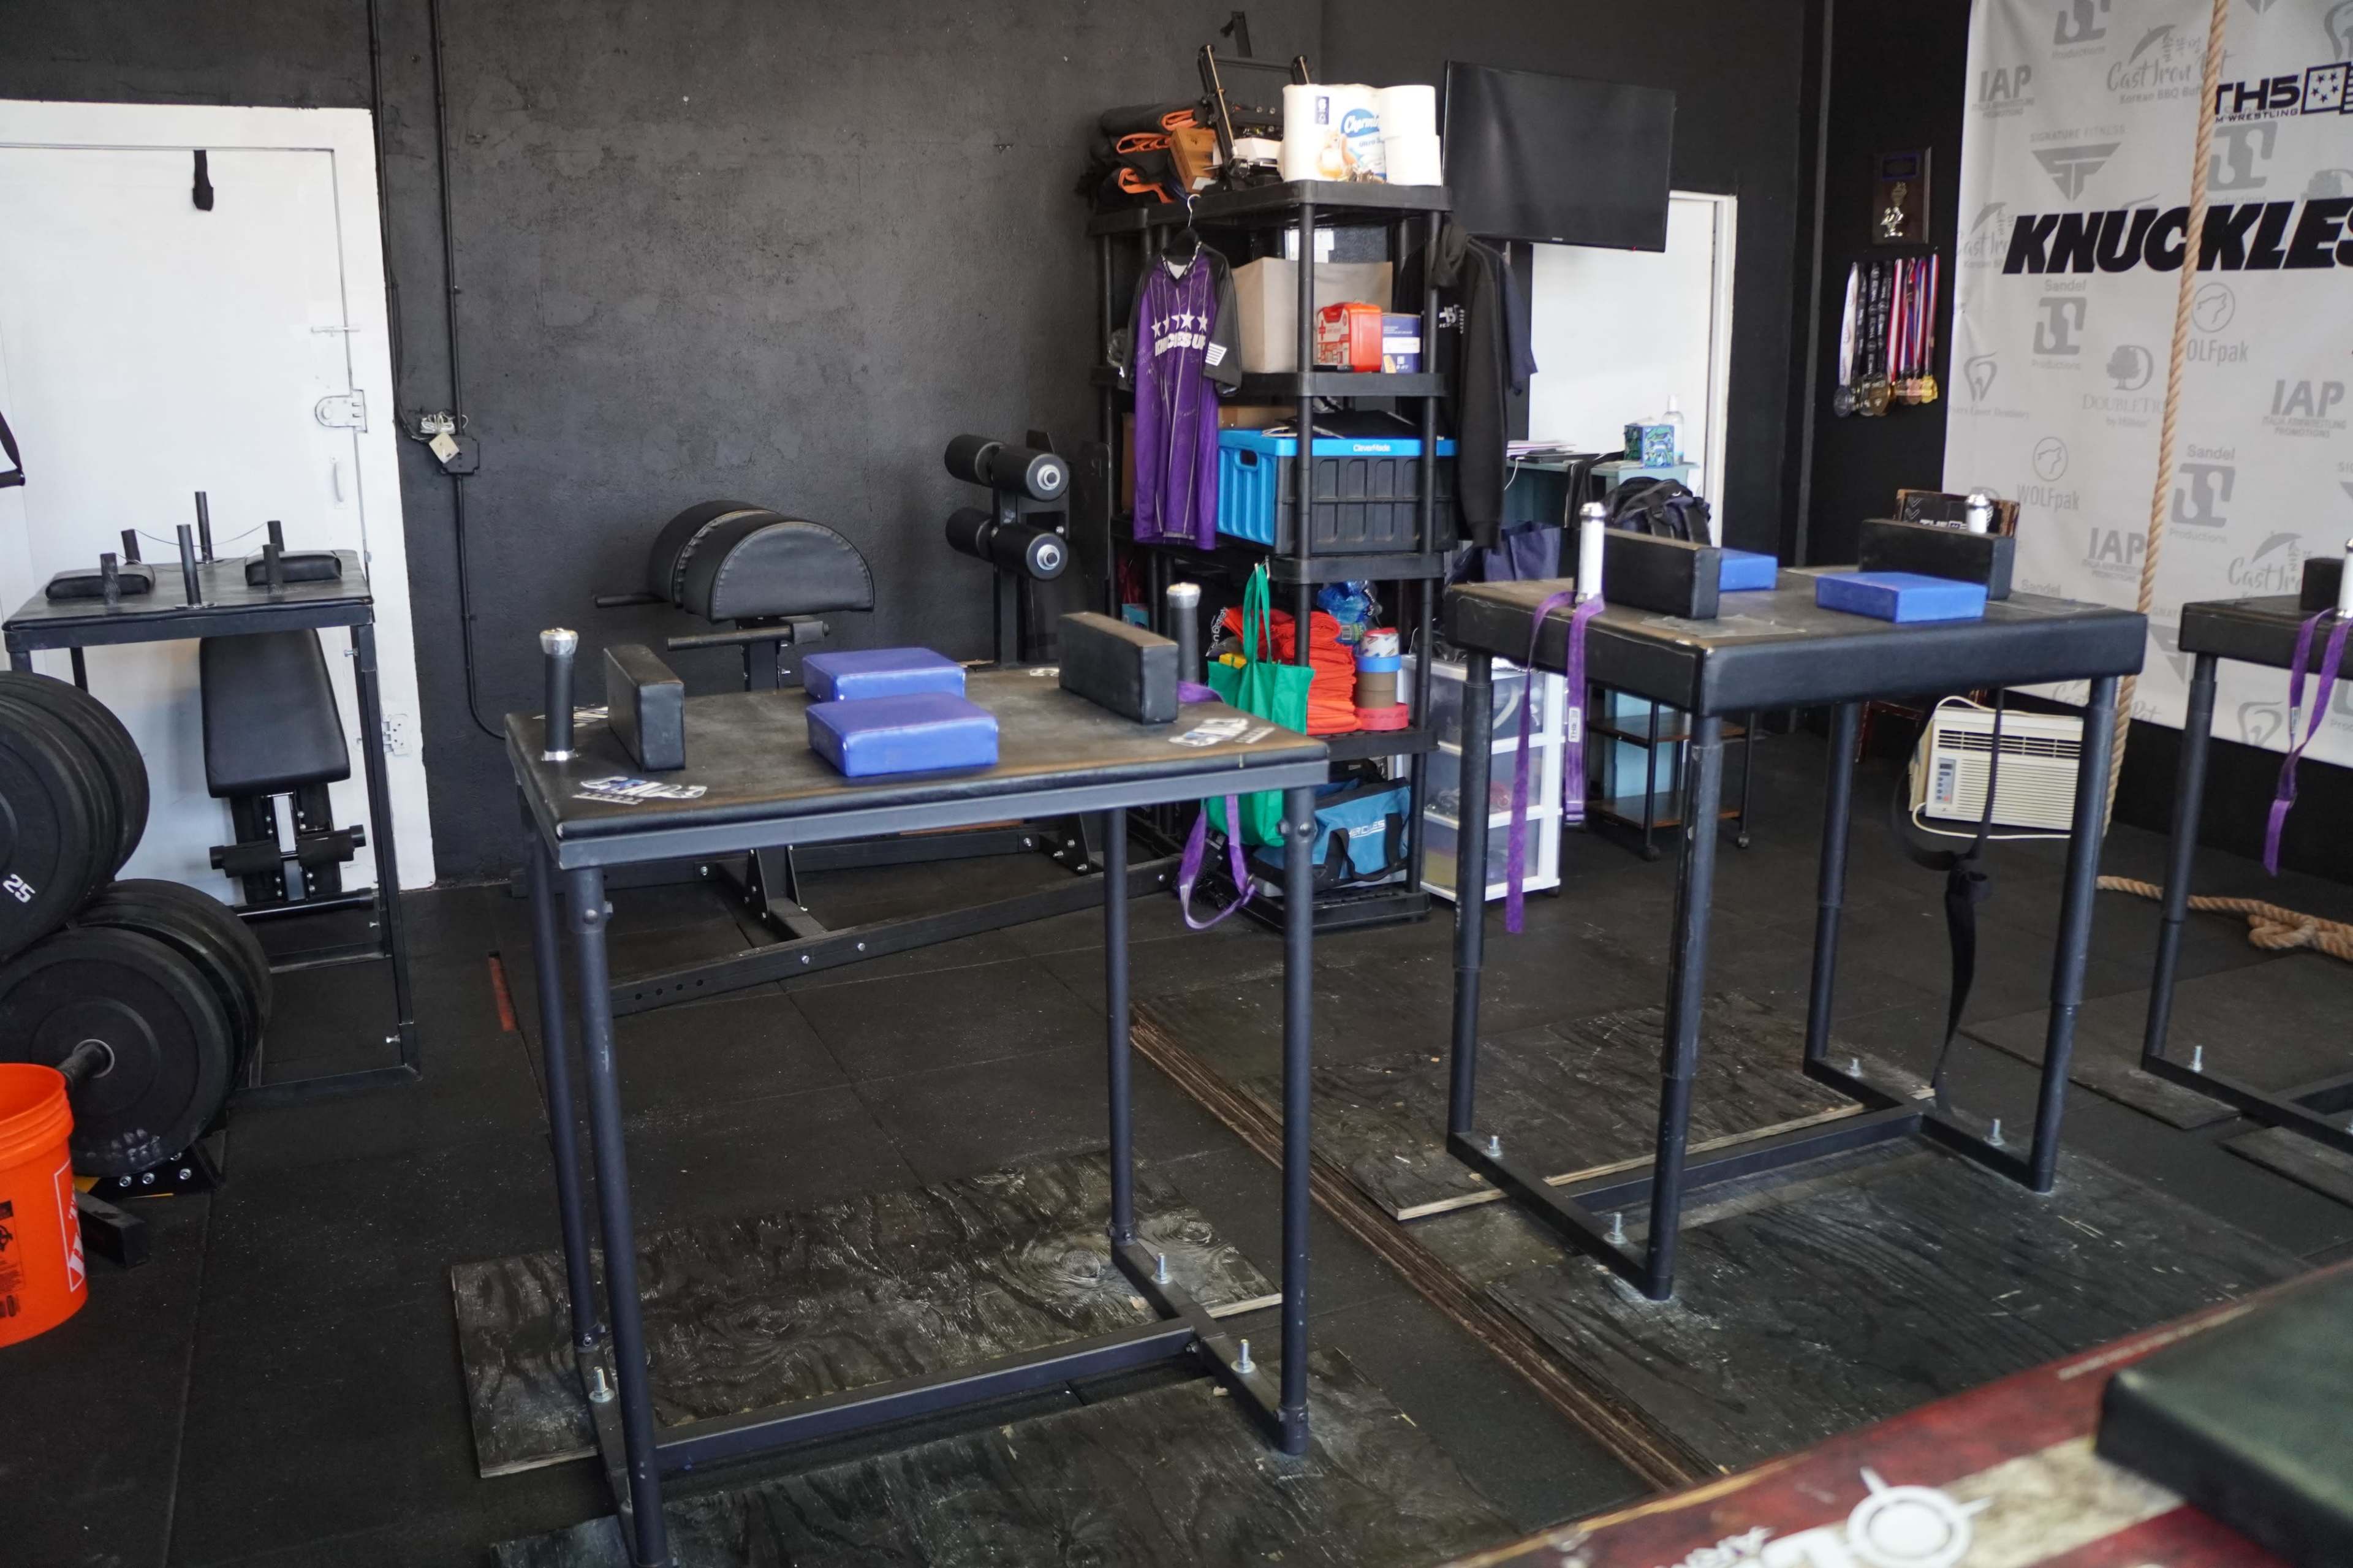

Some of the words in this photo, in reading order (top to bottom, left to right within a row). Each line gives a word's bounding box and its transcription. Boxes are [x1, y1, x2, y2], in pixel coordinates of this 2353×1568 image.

[1979, 64, 2031, 102] IAP
[2107, 59, 2153, 92] Cast
[2153, 59, 2192, 86] Iron
[2157, 87, 2178, 100] BBQ
[2229, 108, 2298, 122] WRESTLING
[2044, 278, 2086, 292] Sandel
[2186, 338, 2249, 367] OLFpak
[2270, 379, 2346, 418] IAP
[2186, 444, 2236, 460] Sandel
[2016, 484, 2080, 513] WOLFpak
[2088, 527, 2146, 564] IAP
[2228, 556, 2277, 591] Cast
[2, 873, 36, 904] 25
